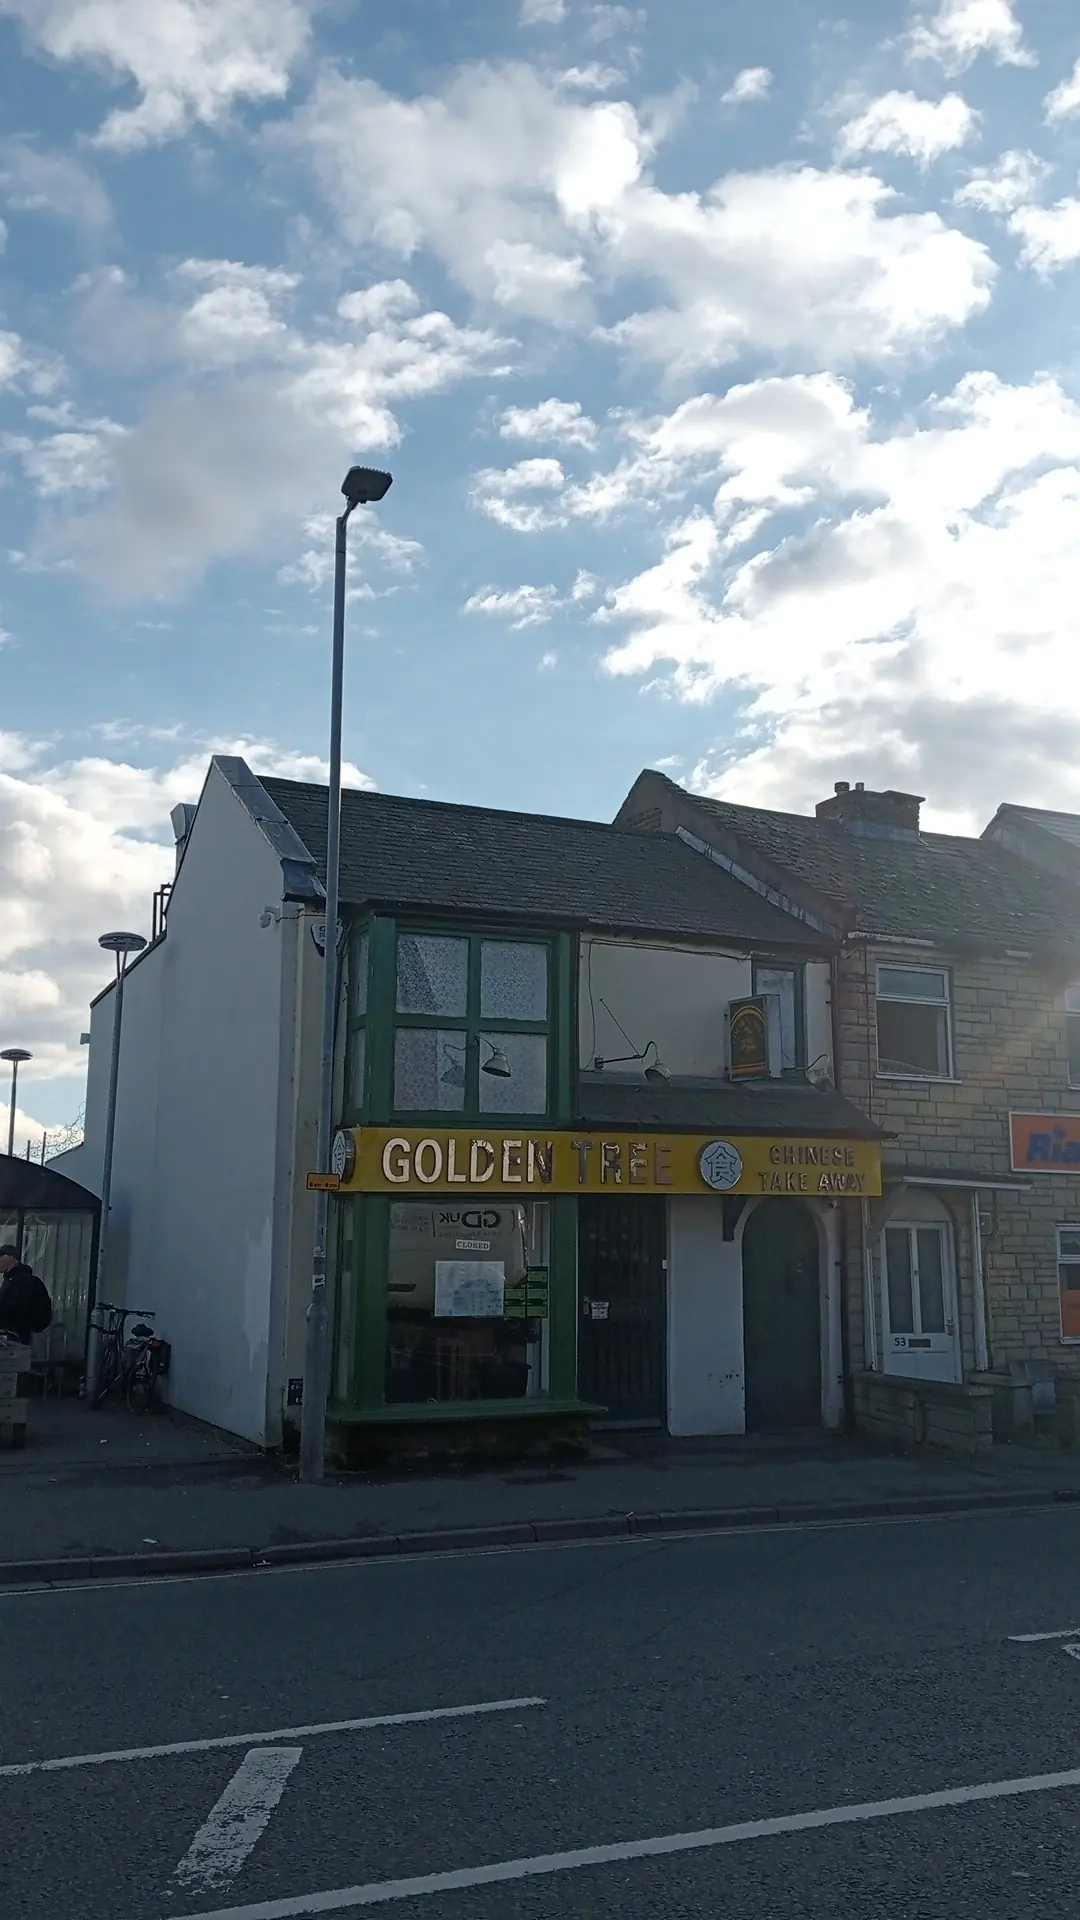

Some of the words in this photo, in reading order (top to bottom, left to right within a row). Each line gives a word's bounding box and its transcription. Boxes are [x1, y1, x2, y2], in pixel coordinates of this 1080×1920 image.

[382, 1137, 553, 1183] GOLDEN
[571, 1140, 674, 1185] TREE
[705, 1146, 738, 1184] 食
[770, 1144, 855, 1166] CHINESE
[759, 1171, 808, 1192] TAKE
[818, 1173, 867, 1192] AWAY
[457, 1240, 489, 1250] CLOSED
[894, 1337, 906, 1347] 53
